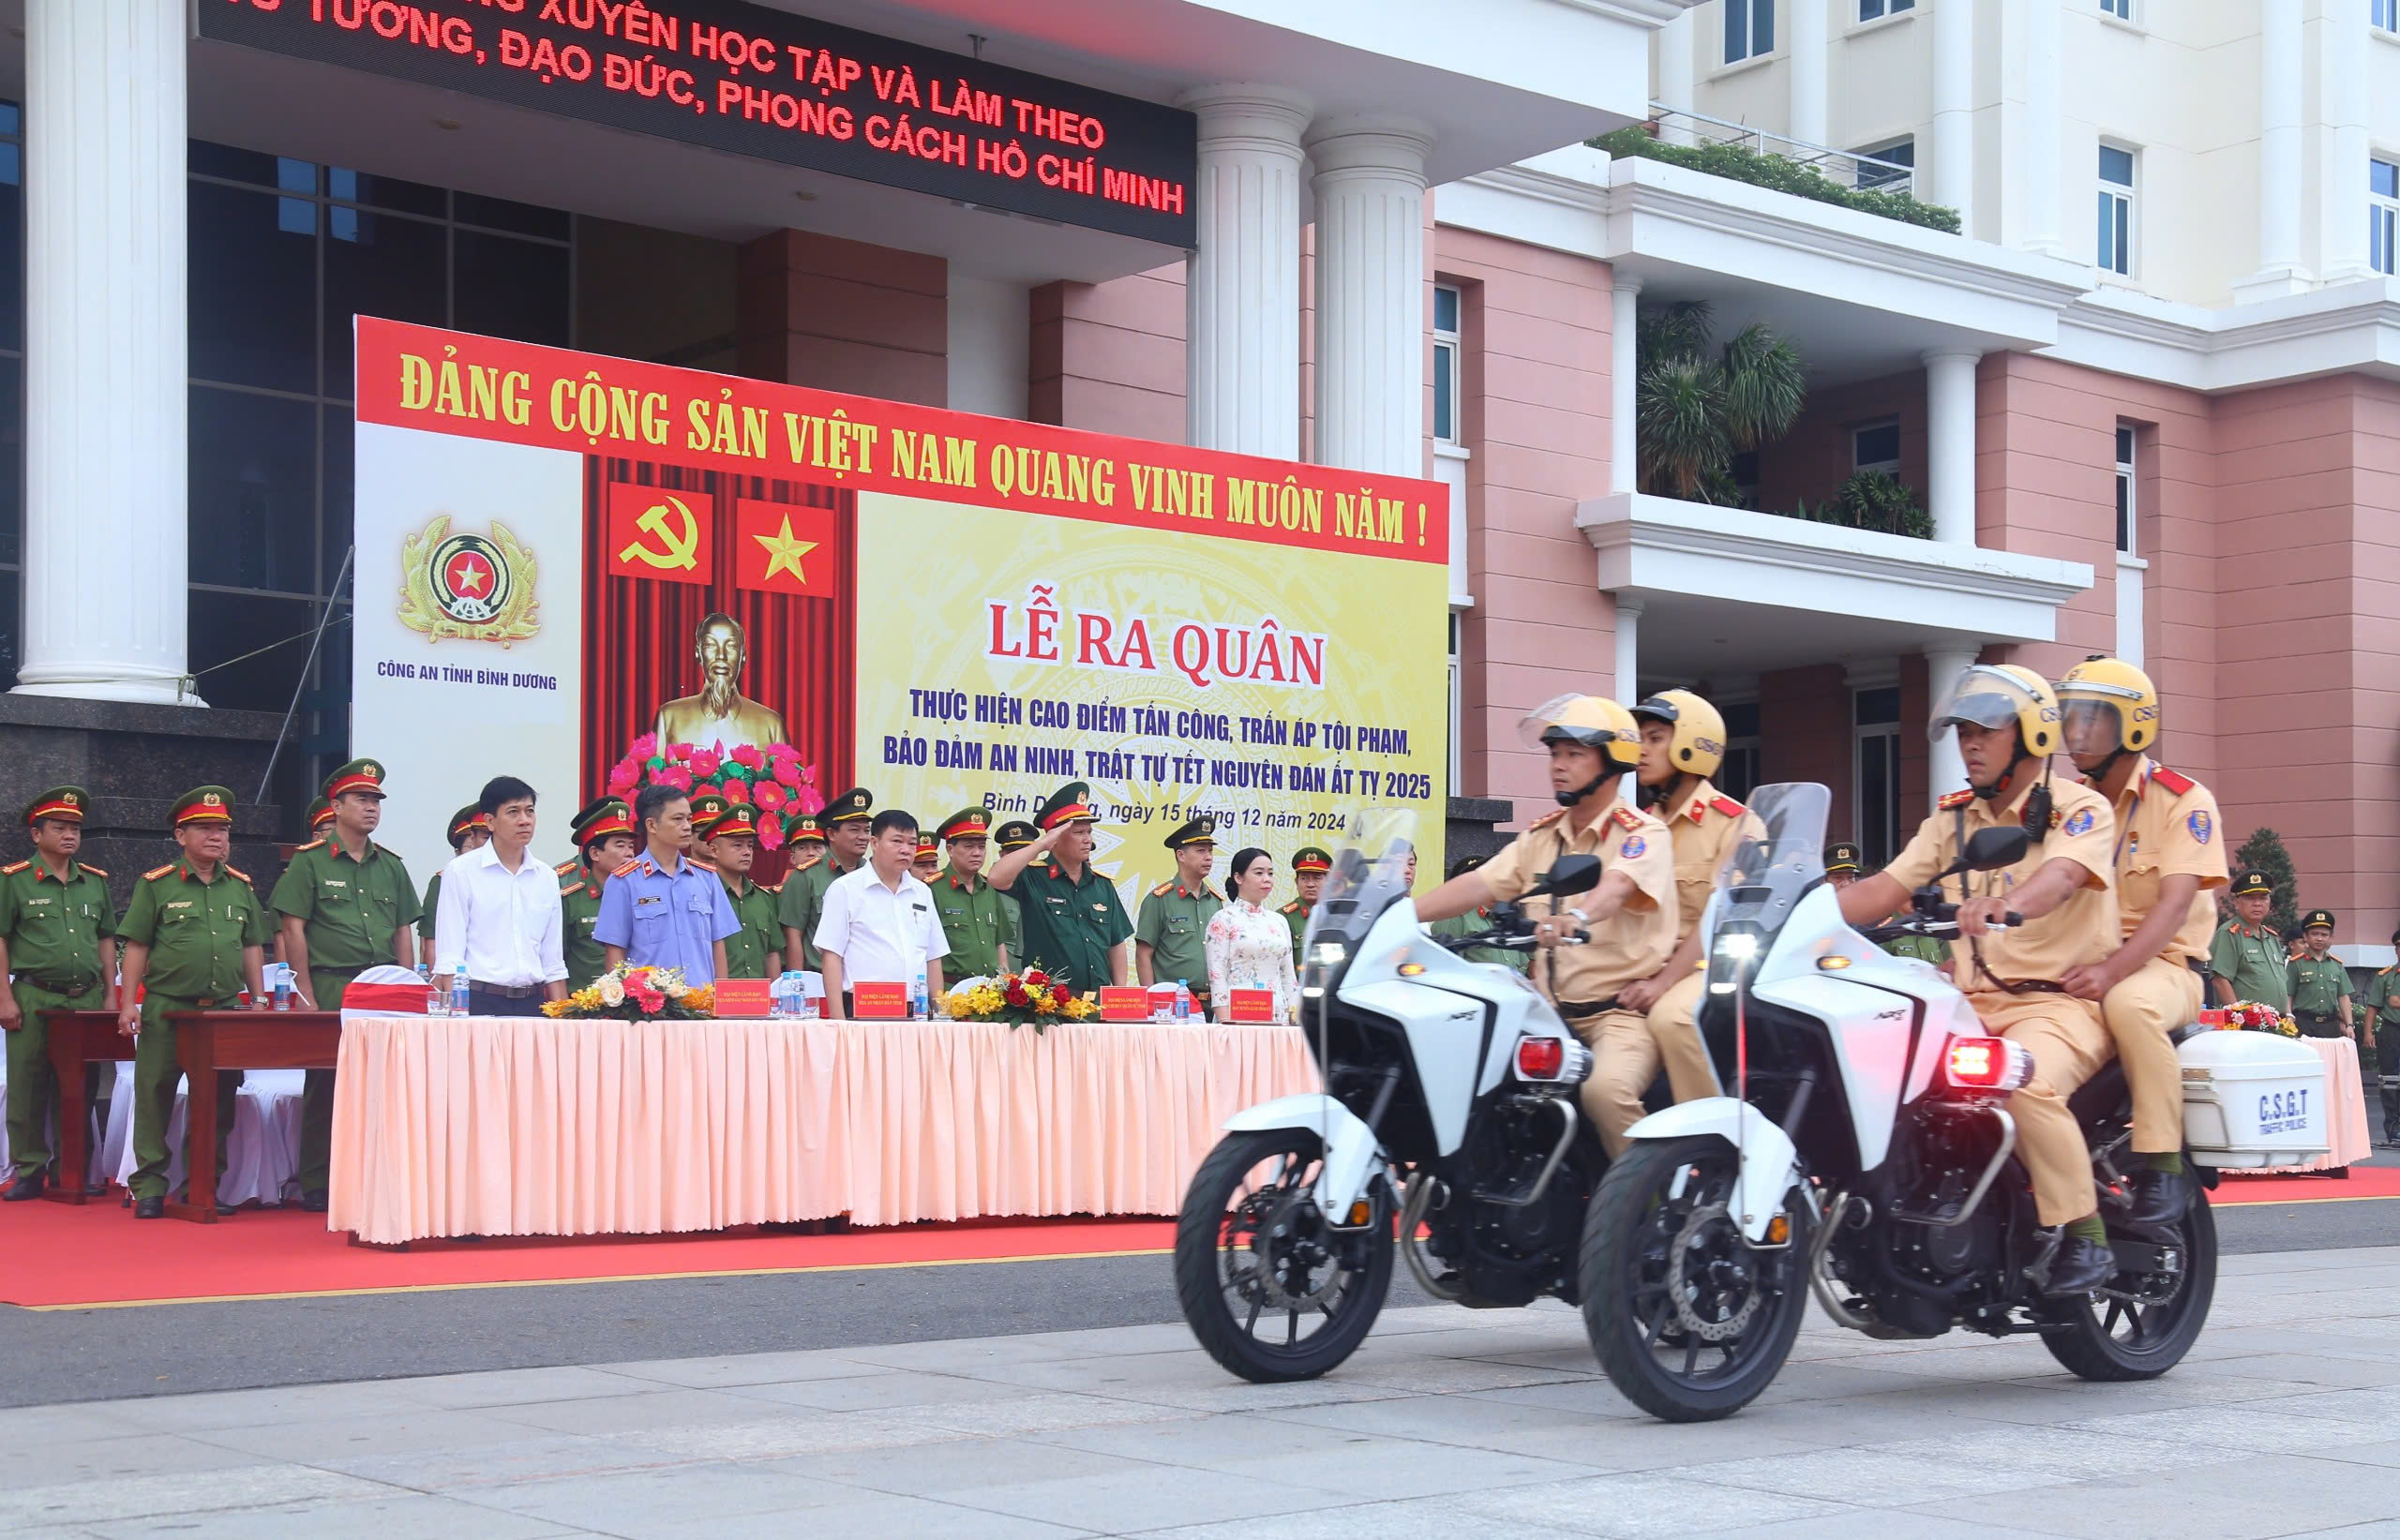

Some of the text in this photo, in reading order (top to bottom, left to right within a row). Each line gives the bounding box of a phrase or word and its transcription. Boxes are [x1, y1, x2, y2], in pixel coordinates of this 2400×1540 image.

[538, 0, 1105, 150] XUYÊN HỌC TẬP VÀ LÀM THEO
[499, 29, 593, 83] ĐẠO
[603, 54, 706, 114] ĐỨC,
[718, 80, 854, 141] PHONG
[864, 113, 967, 167] CÁCH
[977, 139, 1028, 178] HỒ
[1037, 156, 1095, 195] CHÍ
[1103, 167, 1184, 215] MINH
[400, 345, 1427, 547] ĐẢNG CỘNG SẢN VIỆT NAM QUANG VINH MUÔN NĂM !
[989, 584, 1324, 687] LỄ RA QUÂN
[378, 660, 557, 690] CÔNG AN TỈNH BÌNH DƯƠNG
[909, 688, 1411, 758] THỰC HIỆN CAO ĐIỂM TẤN CÔNG, TRẤN ÁP TỘI PHẠM,
[884, 730, 1432, 801] BẢO ĐẢM AN NINH, TRẬT TỰ TẾT NGUYÊN ĐÁN ẤT TỴ 2025
[982, 792, 1027, 813] Bình
[1109, 801, 1155, 825] ngày
[1161, 803, 1180, 822] 15
[1242, 808, 1261, 826] 12
[1266, 811, 1302, 829] năm
[1308, 812, 1346, 830] 2024
[2259, 1089, 2307, 1122] C.S.G.T
